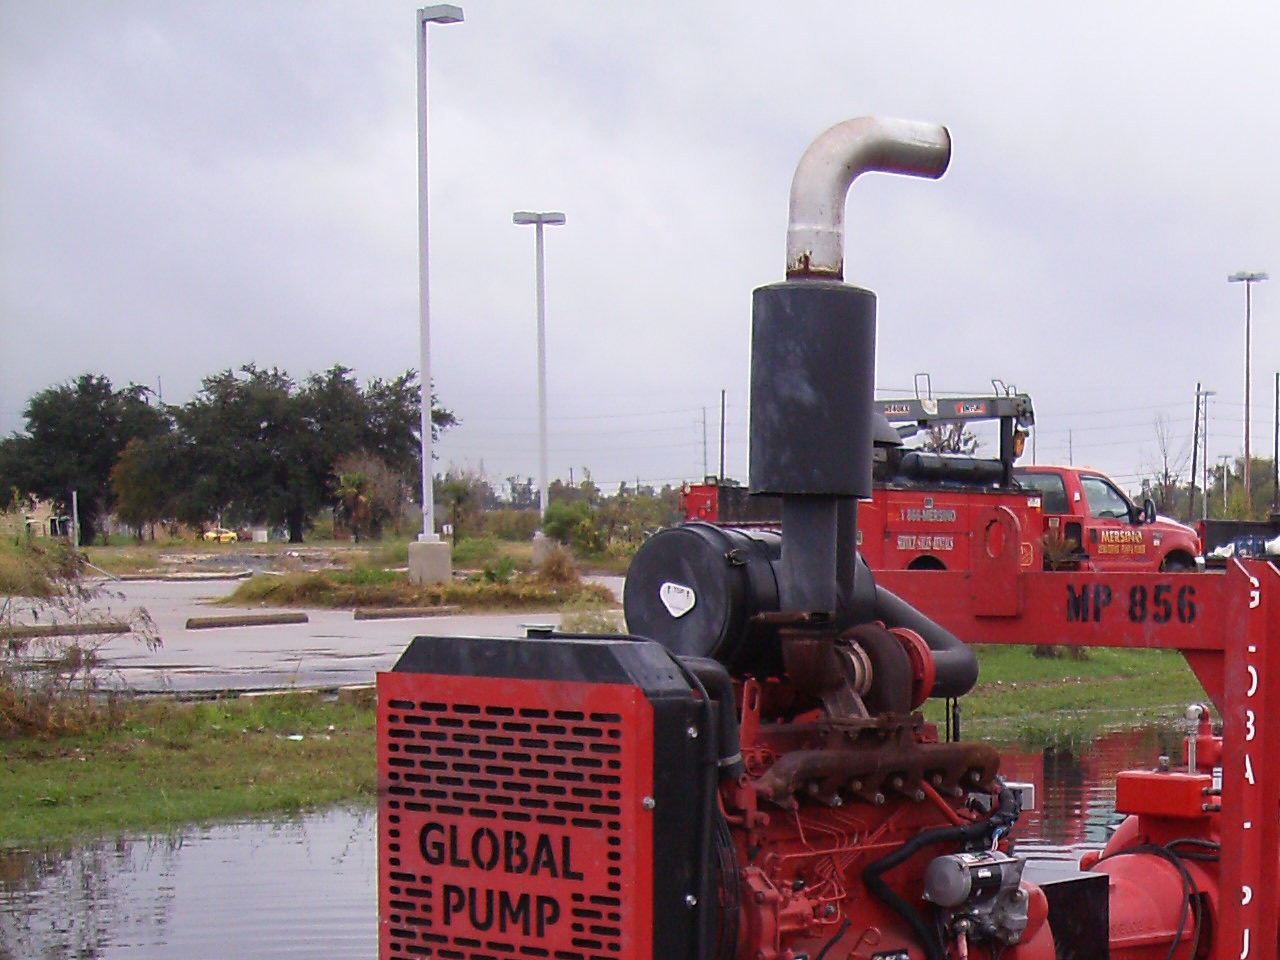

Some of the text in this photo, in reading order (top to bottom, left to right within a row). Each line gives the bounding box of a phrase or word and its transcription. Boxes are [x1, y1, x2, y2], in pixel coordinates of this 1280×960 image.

[1101, 530, 1142, 543] MERSINO
[1067, 584, 1197, 625] MP 856
[419, 822, 584, 882] GLOBAL
[442, 884, 561, 938] PUMP
